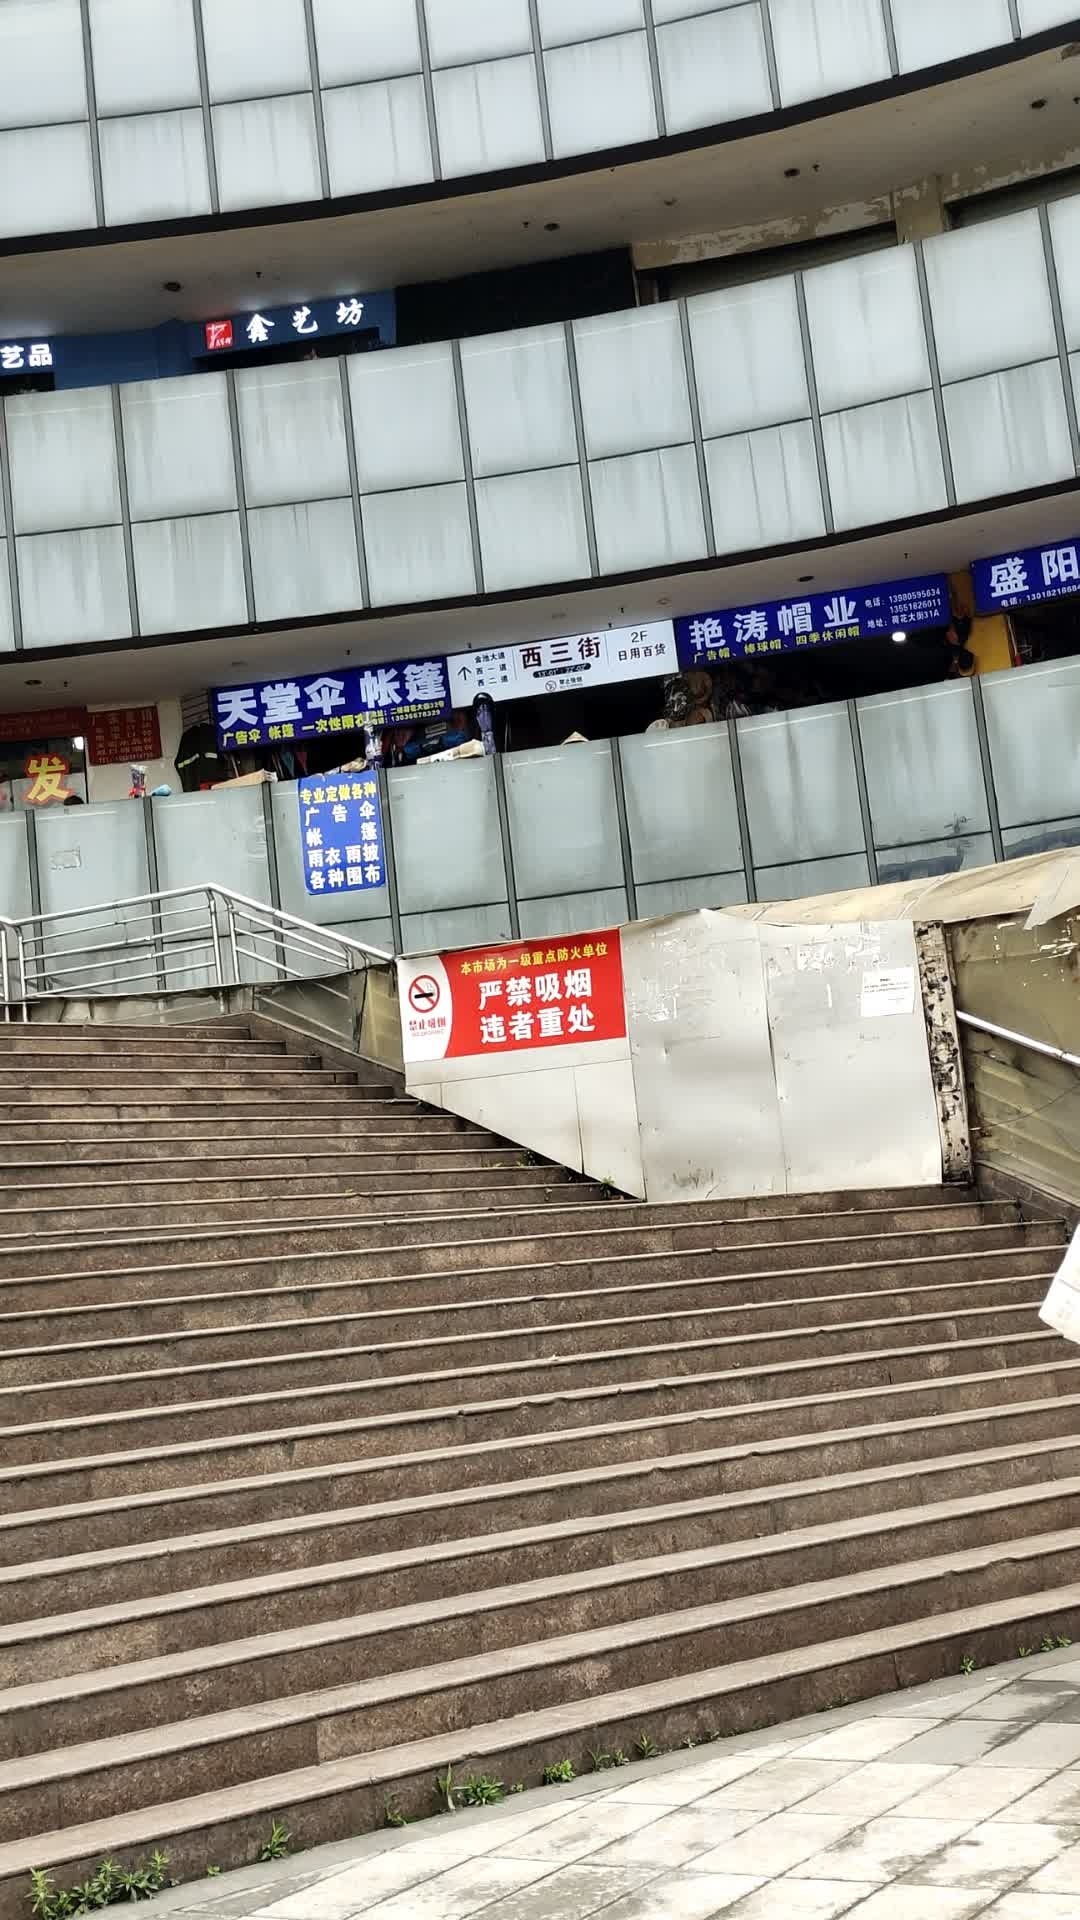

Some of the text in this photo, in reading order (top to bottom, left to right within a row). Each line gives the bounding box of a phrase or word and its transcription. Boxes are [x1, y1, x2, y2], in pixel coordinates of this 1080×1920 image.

[0, 344, 53, 369] 艺品
[990, 546, 1079, 597] 盛阳
[630, 630, 648, 643] 2F
[688, 597, 859, 651] 艳涛帽业
[518, 636, 600, 669] 西三街
[618, 643, 666, 661] 日用百货
[217, 661, 446, 730] 天堂伞 帐篷
[223, 729, 261, 747] 广告伞
[27, 756, 70, 801] 发
[299, 782, 376, 805] 专业定做各种
[310, 864, 380, 890] 各种围布
[460, 943, 608, 976] 本市场为一级重点防火单位
[479, 968, 592, 1011] 严禁吸烟
[480, 1003, 596, 1045] 违者重处
